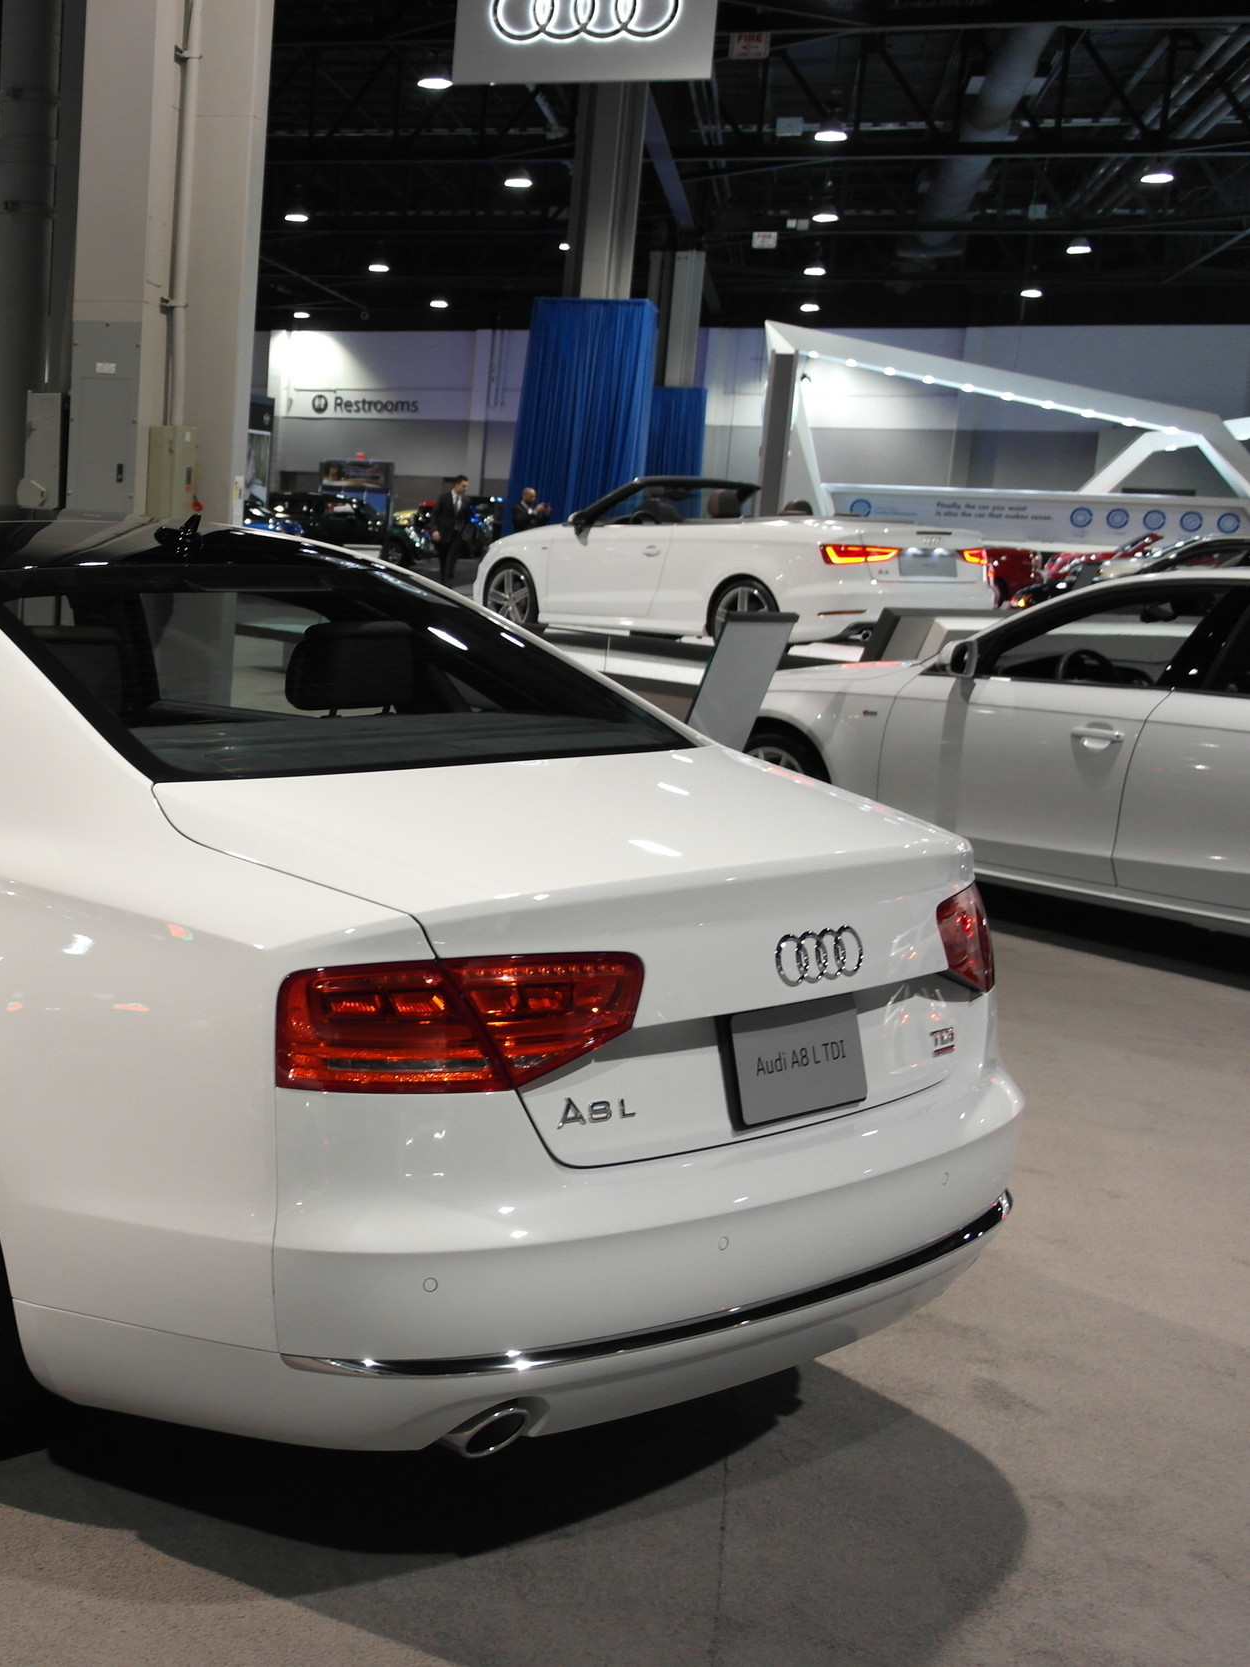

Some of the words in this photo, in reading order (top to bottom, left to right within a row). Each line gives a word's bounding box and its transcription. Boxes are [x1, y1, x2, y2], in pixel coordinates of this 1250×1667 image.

[334, 395, 419, 414] Restrooms
[756, 1051, 787, 1077] Audi
[791, 1046, 810, 1069] A8
[812, 1045, 821, 1064] L
[821, 1039, 846, 1062] TDI
[556, 1097, 612, 1130] A8
[618, 1098, 637, 1119] L
